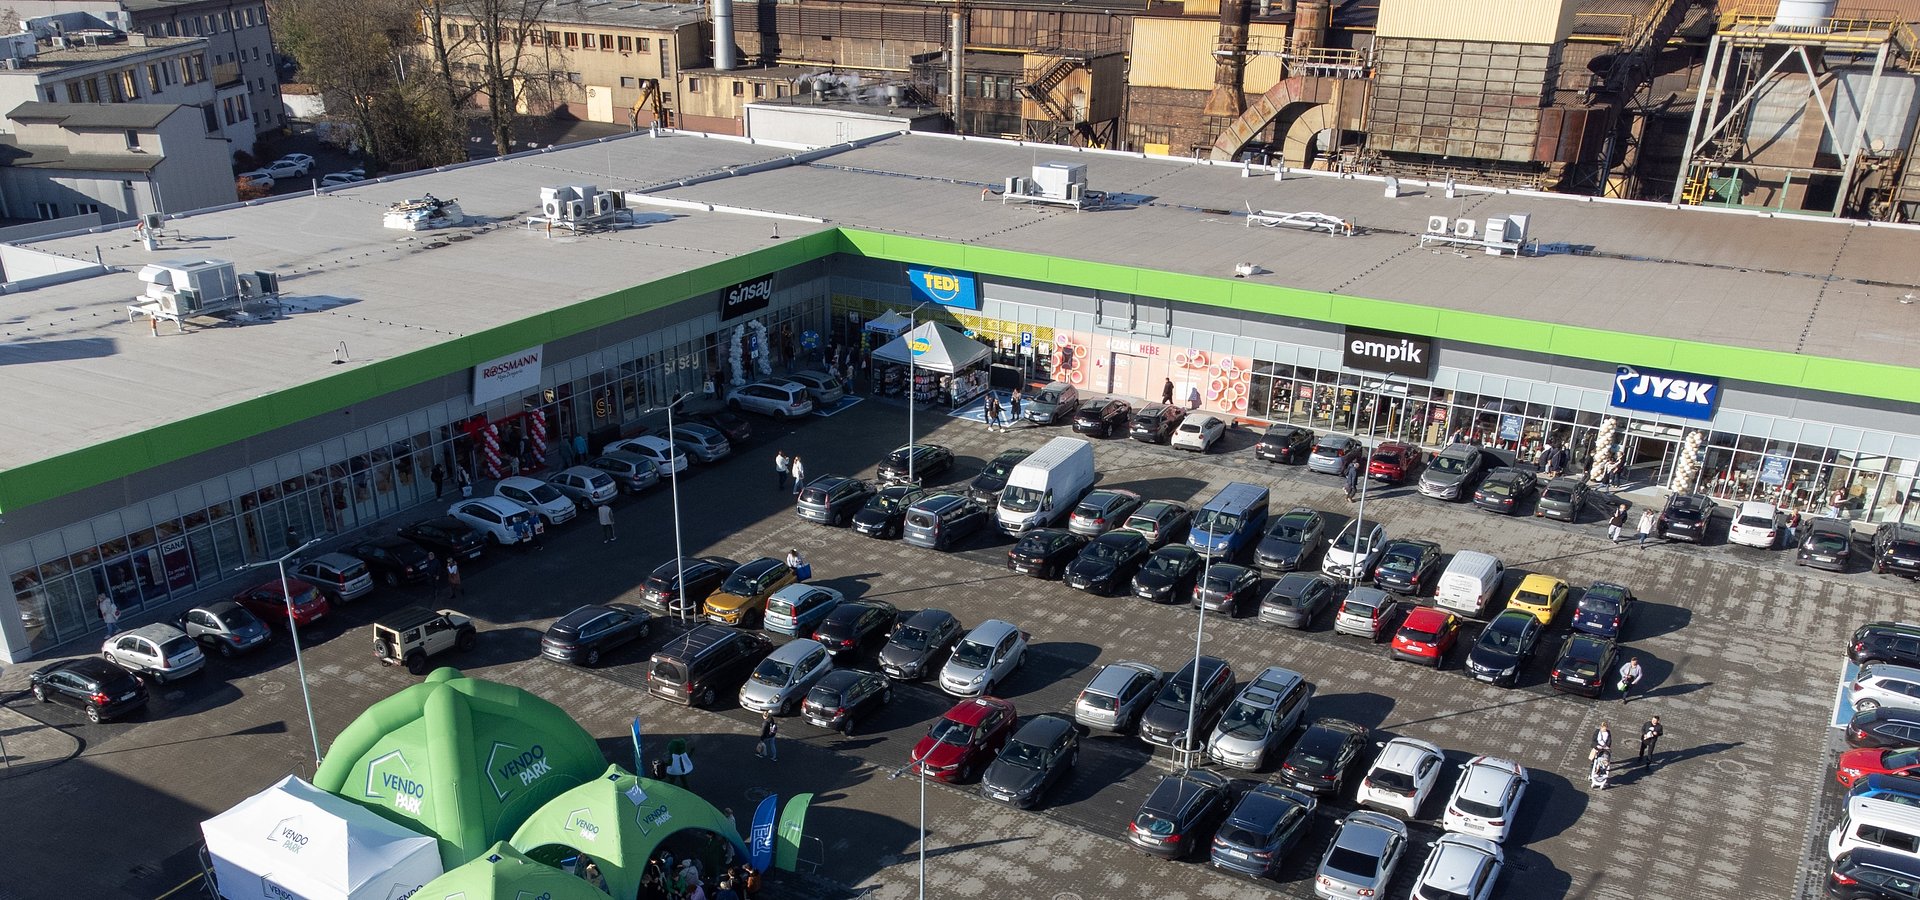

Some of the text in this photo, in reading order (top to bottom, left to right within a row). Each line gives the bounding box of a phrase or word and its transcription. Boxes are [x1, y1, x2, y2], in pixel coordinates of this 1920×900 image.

[728, 278, 773, 306] sinsay
[924, 273, 960, 293] TEDi
[1023, 333, 1031, 344] P
[1140, 344, 1160, 356] HEBE
[1350, 339, 1422, 363] empik
[483, 353, 539, 379] ROSSMANN
[1632, 375, 1713, 404] JYSK
[499, 744, 545, 780] VENDO
[519, 757, 552, 787] PARK
[383, 771, 424, 799] VENDO
[394, 791, 422, 816] PARK
[643, 804, 668, 825] VENDO
[654, 810, 673, 828] PARK
[282, 827, 309, 846] VENDO
[576, 818, 600, 834] VENDO
[579, 829, 598, 843] PARK
[282, 842, 302, 854] PARK
